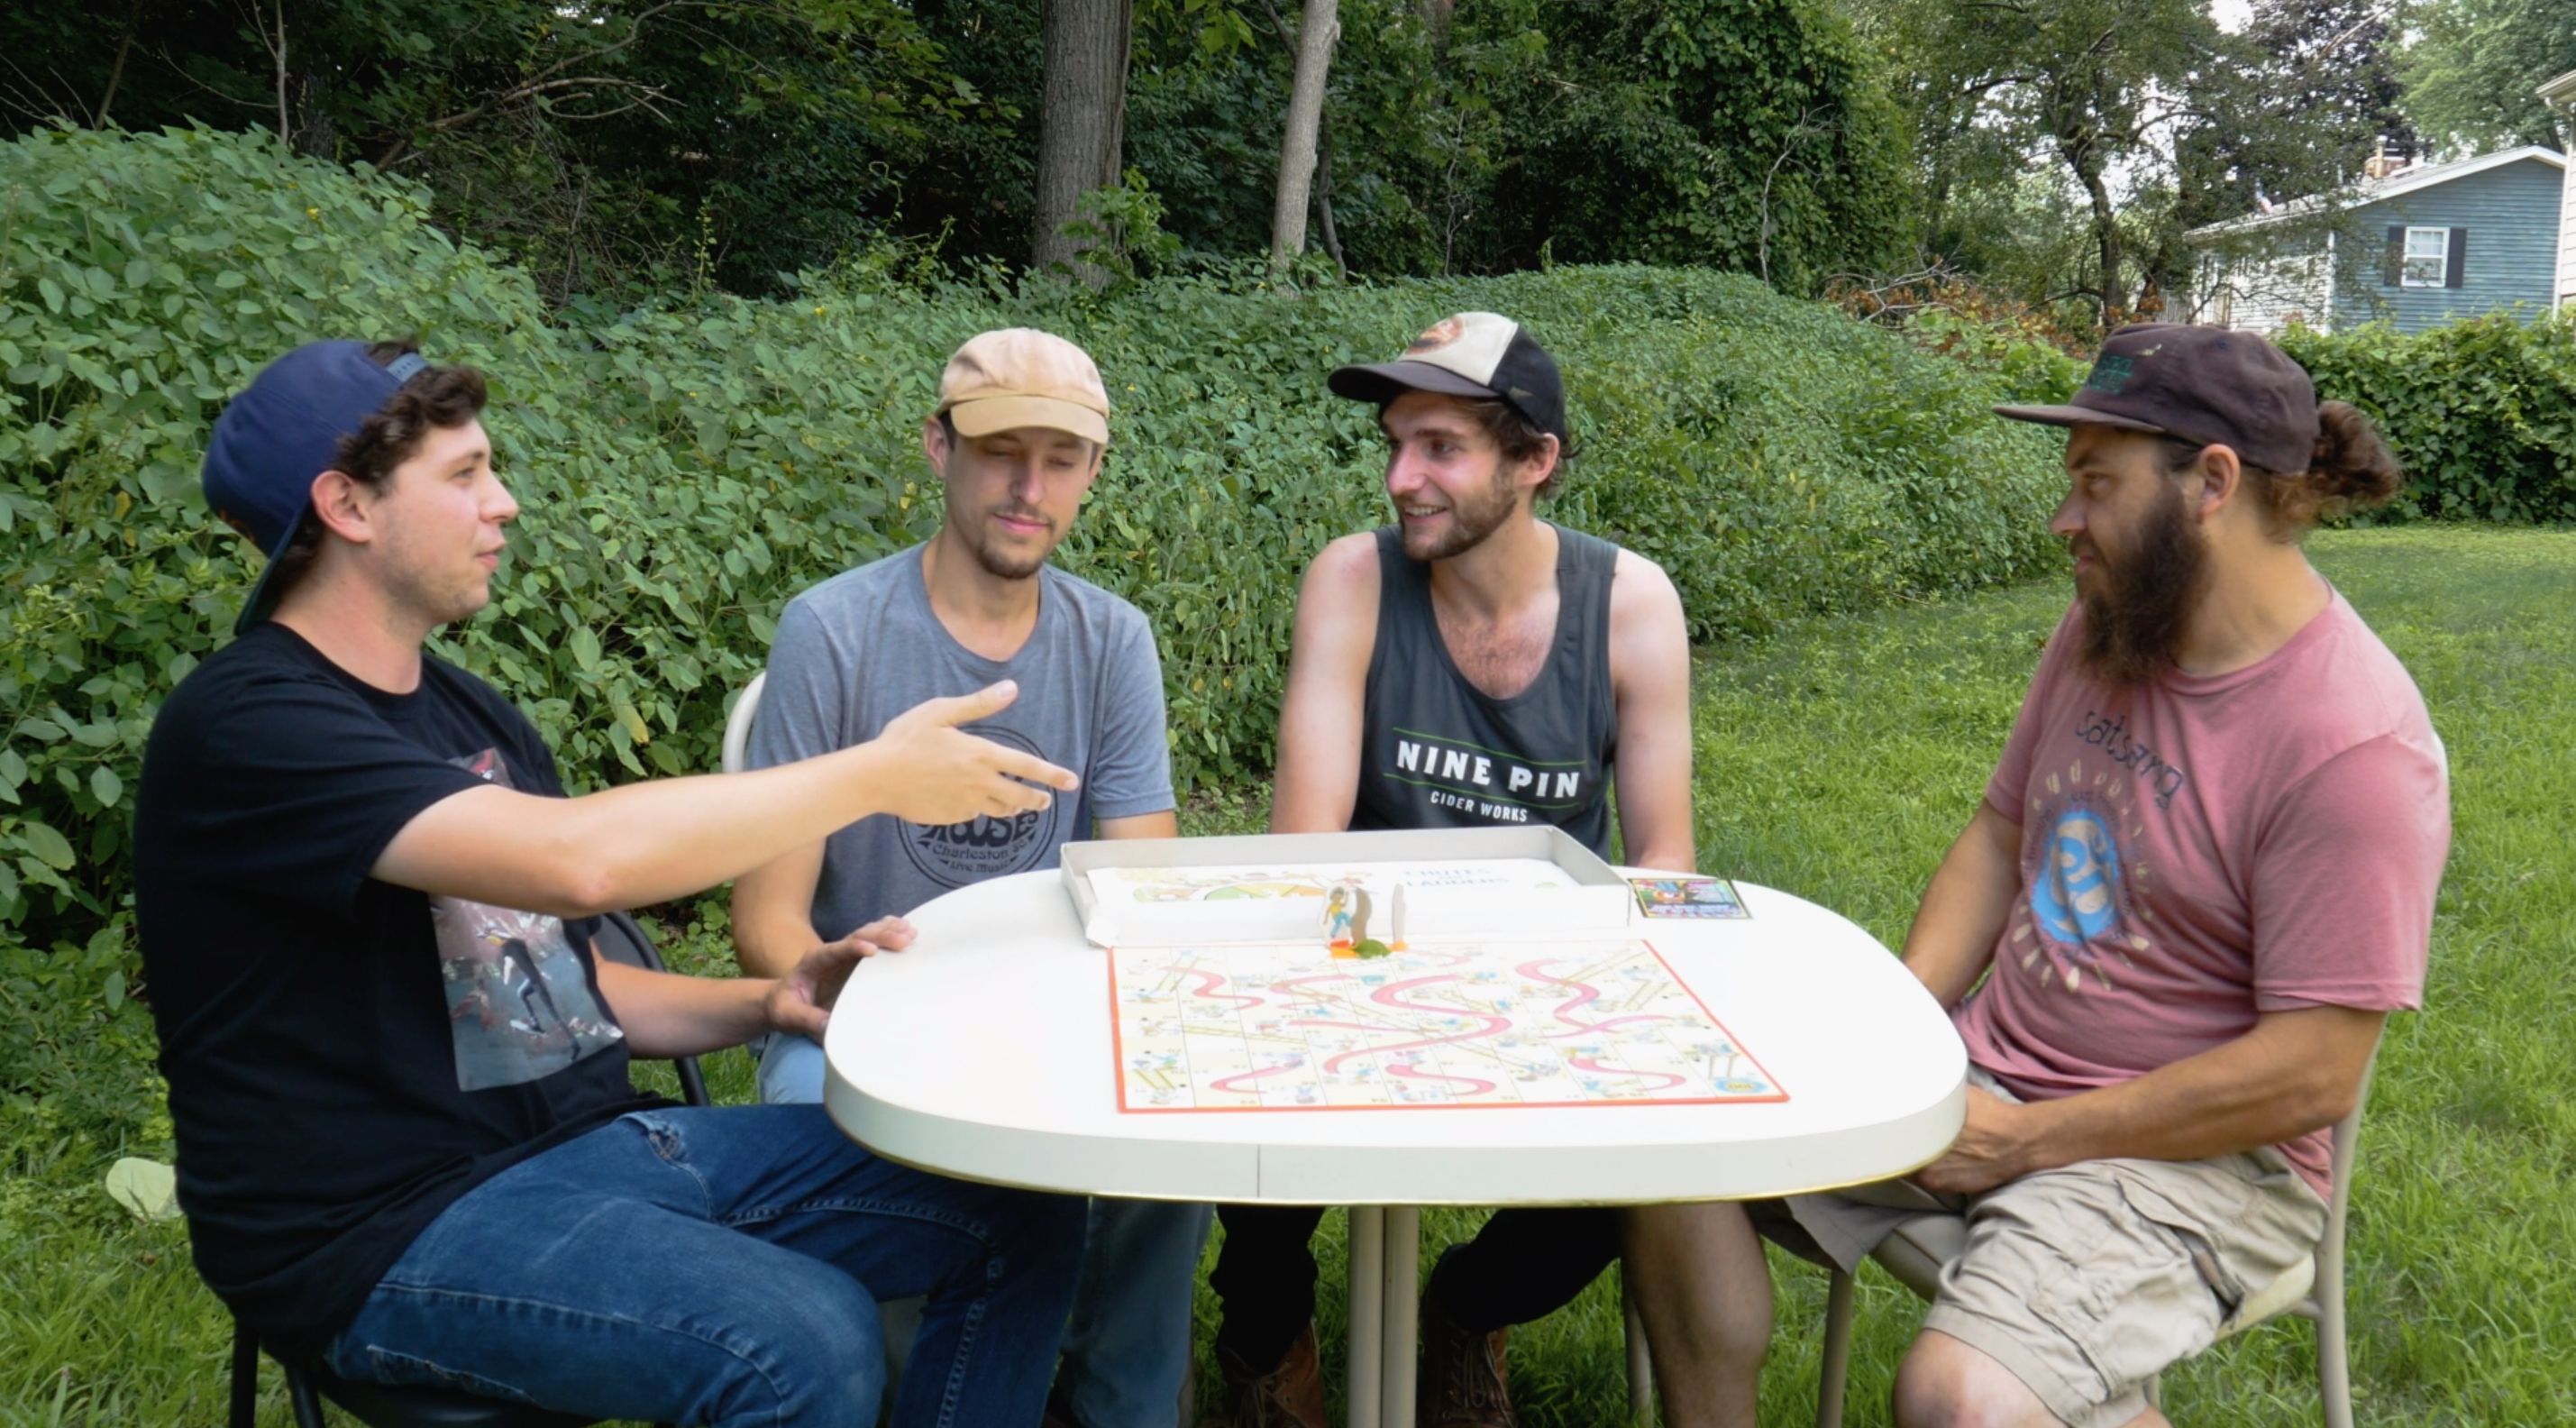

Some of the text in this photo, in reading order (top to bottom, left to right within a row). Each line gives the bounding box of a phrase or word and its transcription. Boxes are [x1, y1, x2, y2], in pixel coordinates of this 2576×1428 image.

[1397, 740, 1580, 798] NINE PIN
[1430, 790, 1529, 823] CIDER WORKS
[933, 842, 1009, 860] Charleston
[950, 860, 1009, 873] Live Music
